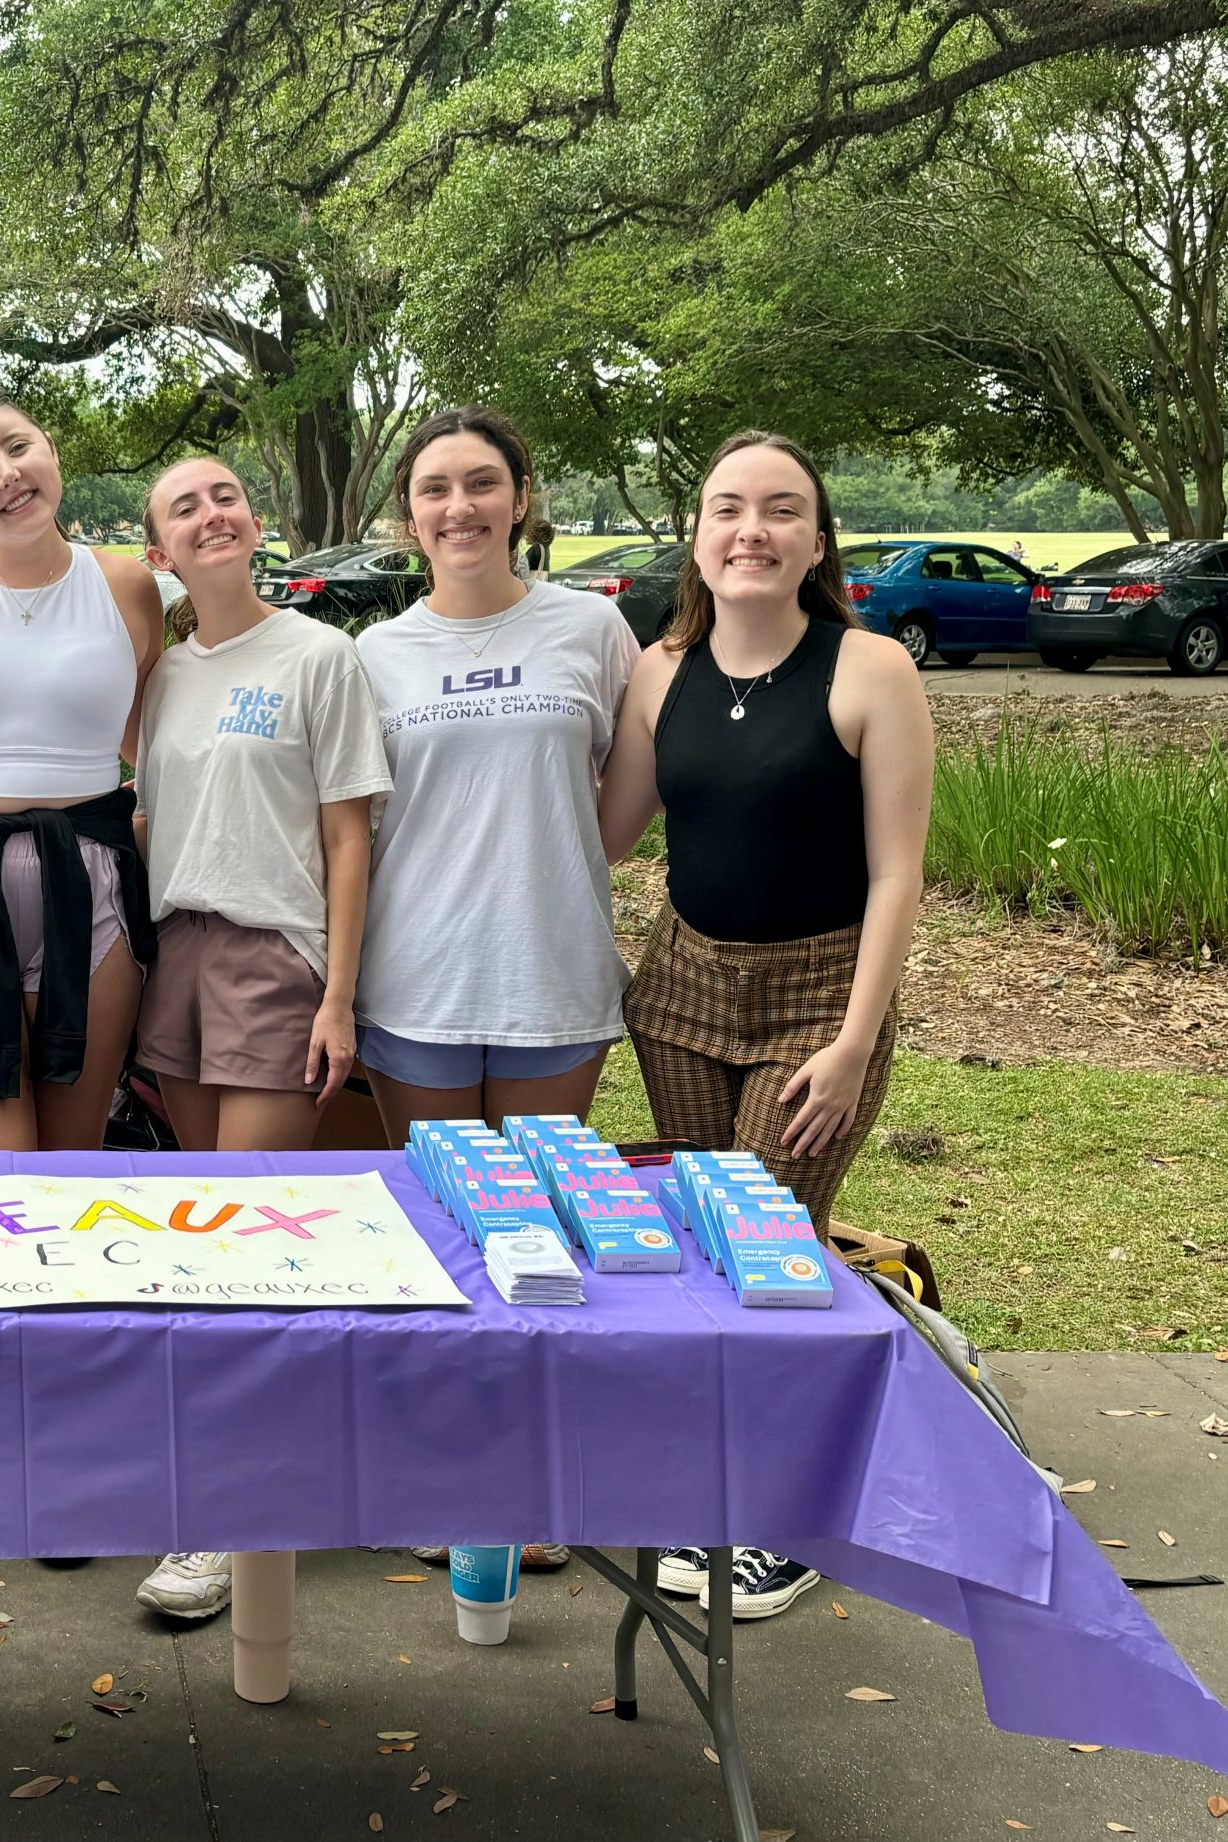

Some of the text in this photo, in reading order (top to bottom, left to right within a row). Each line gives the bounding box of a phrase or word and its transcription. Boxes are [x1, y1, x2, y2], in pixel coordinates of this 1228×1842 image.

[442, 665, 521, 696] LSU
[230, 686, 284, 709] Take
[425, 697, 496, 712] FOOTBALL'S
[501, 694, 531, 704] ONLY
[236, 700, 273, 726] My
[382, 702, 584, 739] BCS NATIONAL CHAMPION
[216, 716, 278, 740] Hand
[559, 1168, 639, 1191] Julie
[470, 1187, 553, 1210] Julie
[578, 1197, 663, 1218] Julie
[726, 1213, 817, 1240] Julie
[737, 1248, 781, 1256] Emergency
[172, 1281, 369, 1300] @geauxec
